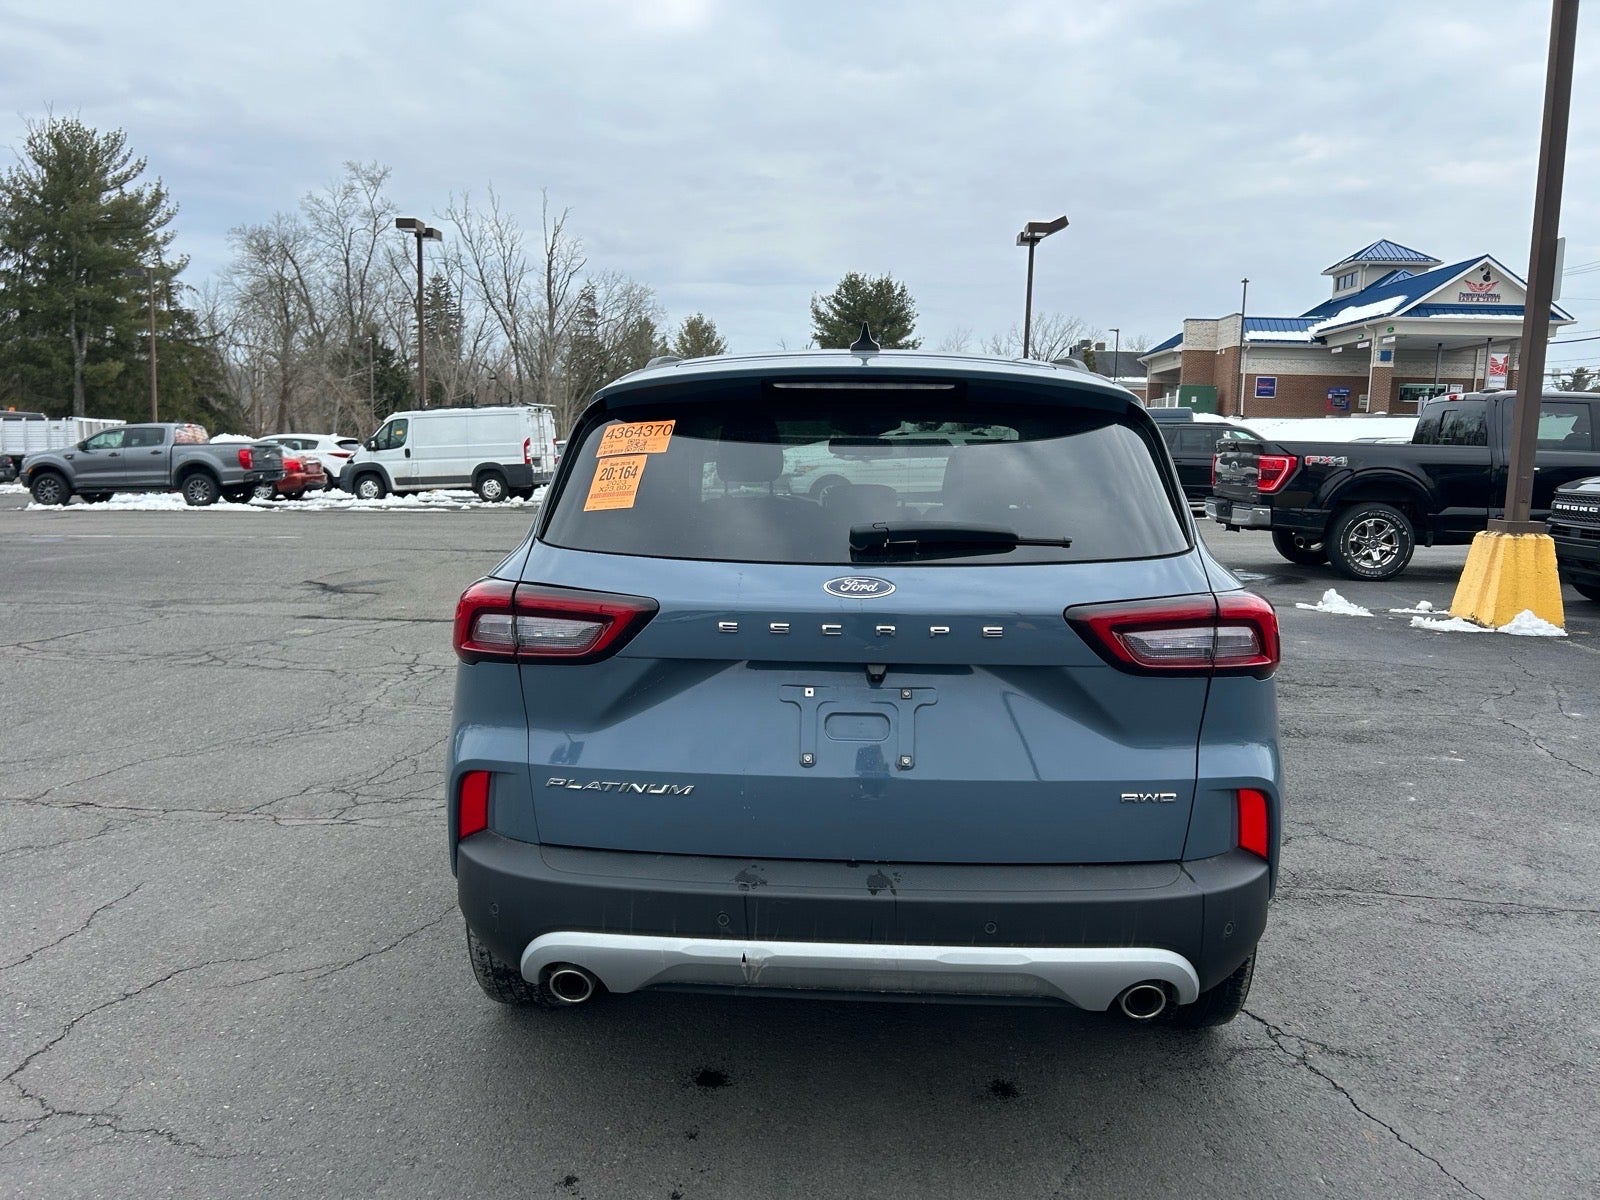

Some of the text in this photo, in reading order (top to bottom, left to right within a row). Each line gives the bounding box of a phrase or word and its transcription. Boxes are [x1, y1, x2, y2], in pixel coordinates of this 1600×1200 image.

[605, 424, 673, 440] 4364370
[1305, 455, 1348, 467] FX4
[599, 465, 639, 481] 20:164
[840, 577, 878, 593] Ford
[718, 622, 1004, 639] ESCAPE
[545, 777, 695, 795] PLATINUM
[1120, 793, 1177, 802] AWD
